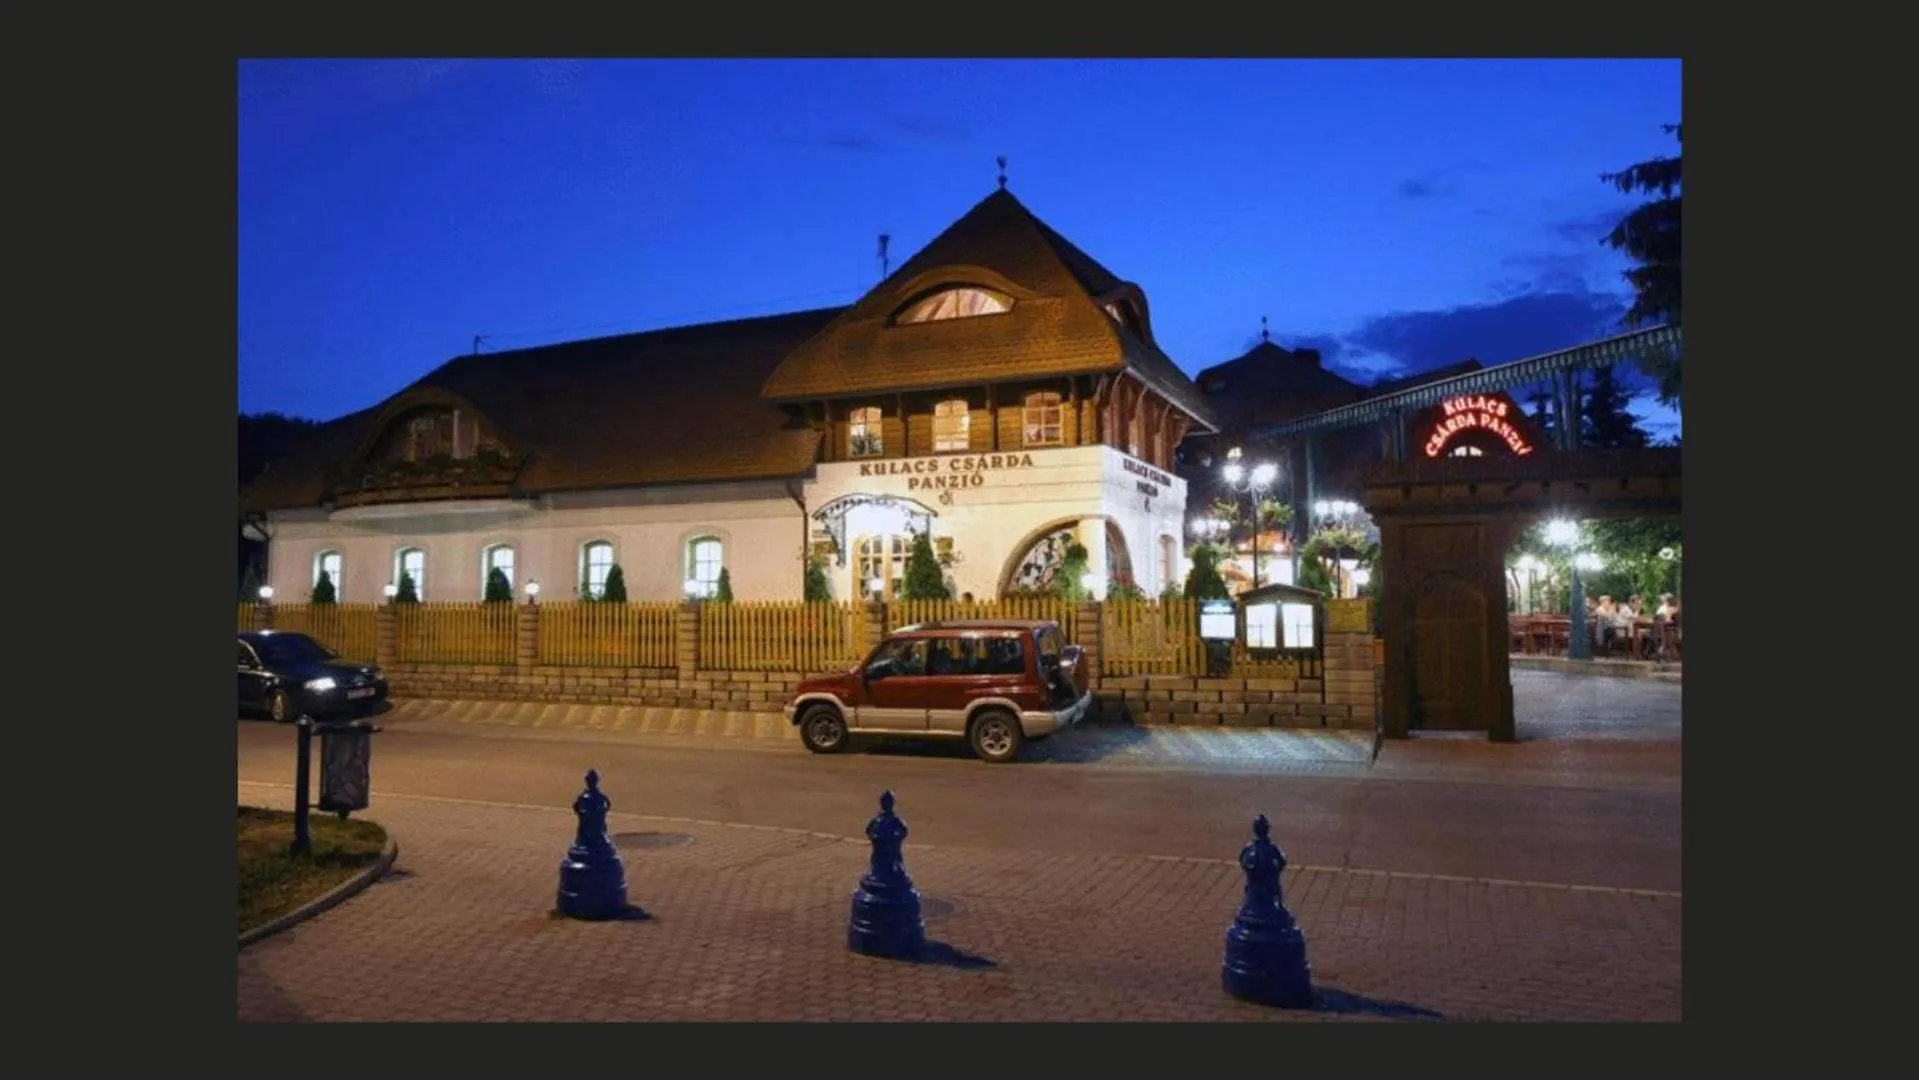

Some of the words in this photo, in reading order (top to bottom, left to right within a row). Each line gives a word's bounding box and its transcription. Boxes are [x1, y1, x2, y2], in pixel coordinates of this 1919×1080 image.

[1443, 396, 1507, 417] KULACS
[859, 459, 939, 477] KULACS
[950, 453, 1033, 471] CSÁRDA
[908, 470, 984, 490] PANZIÓ
